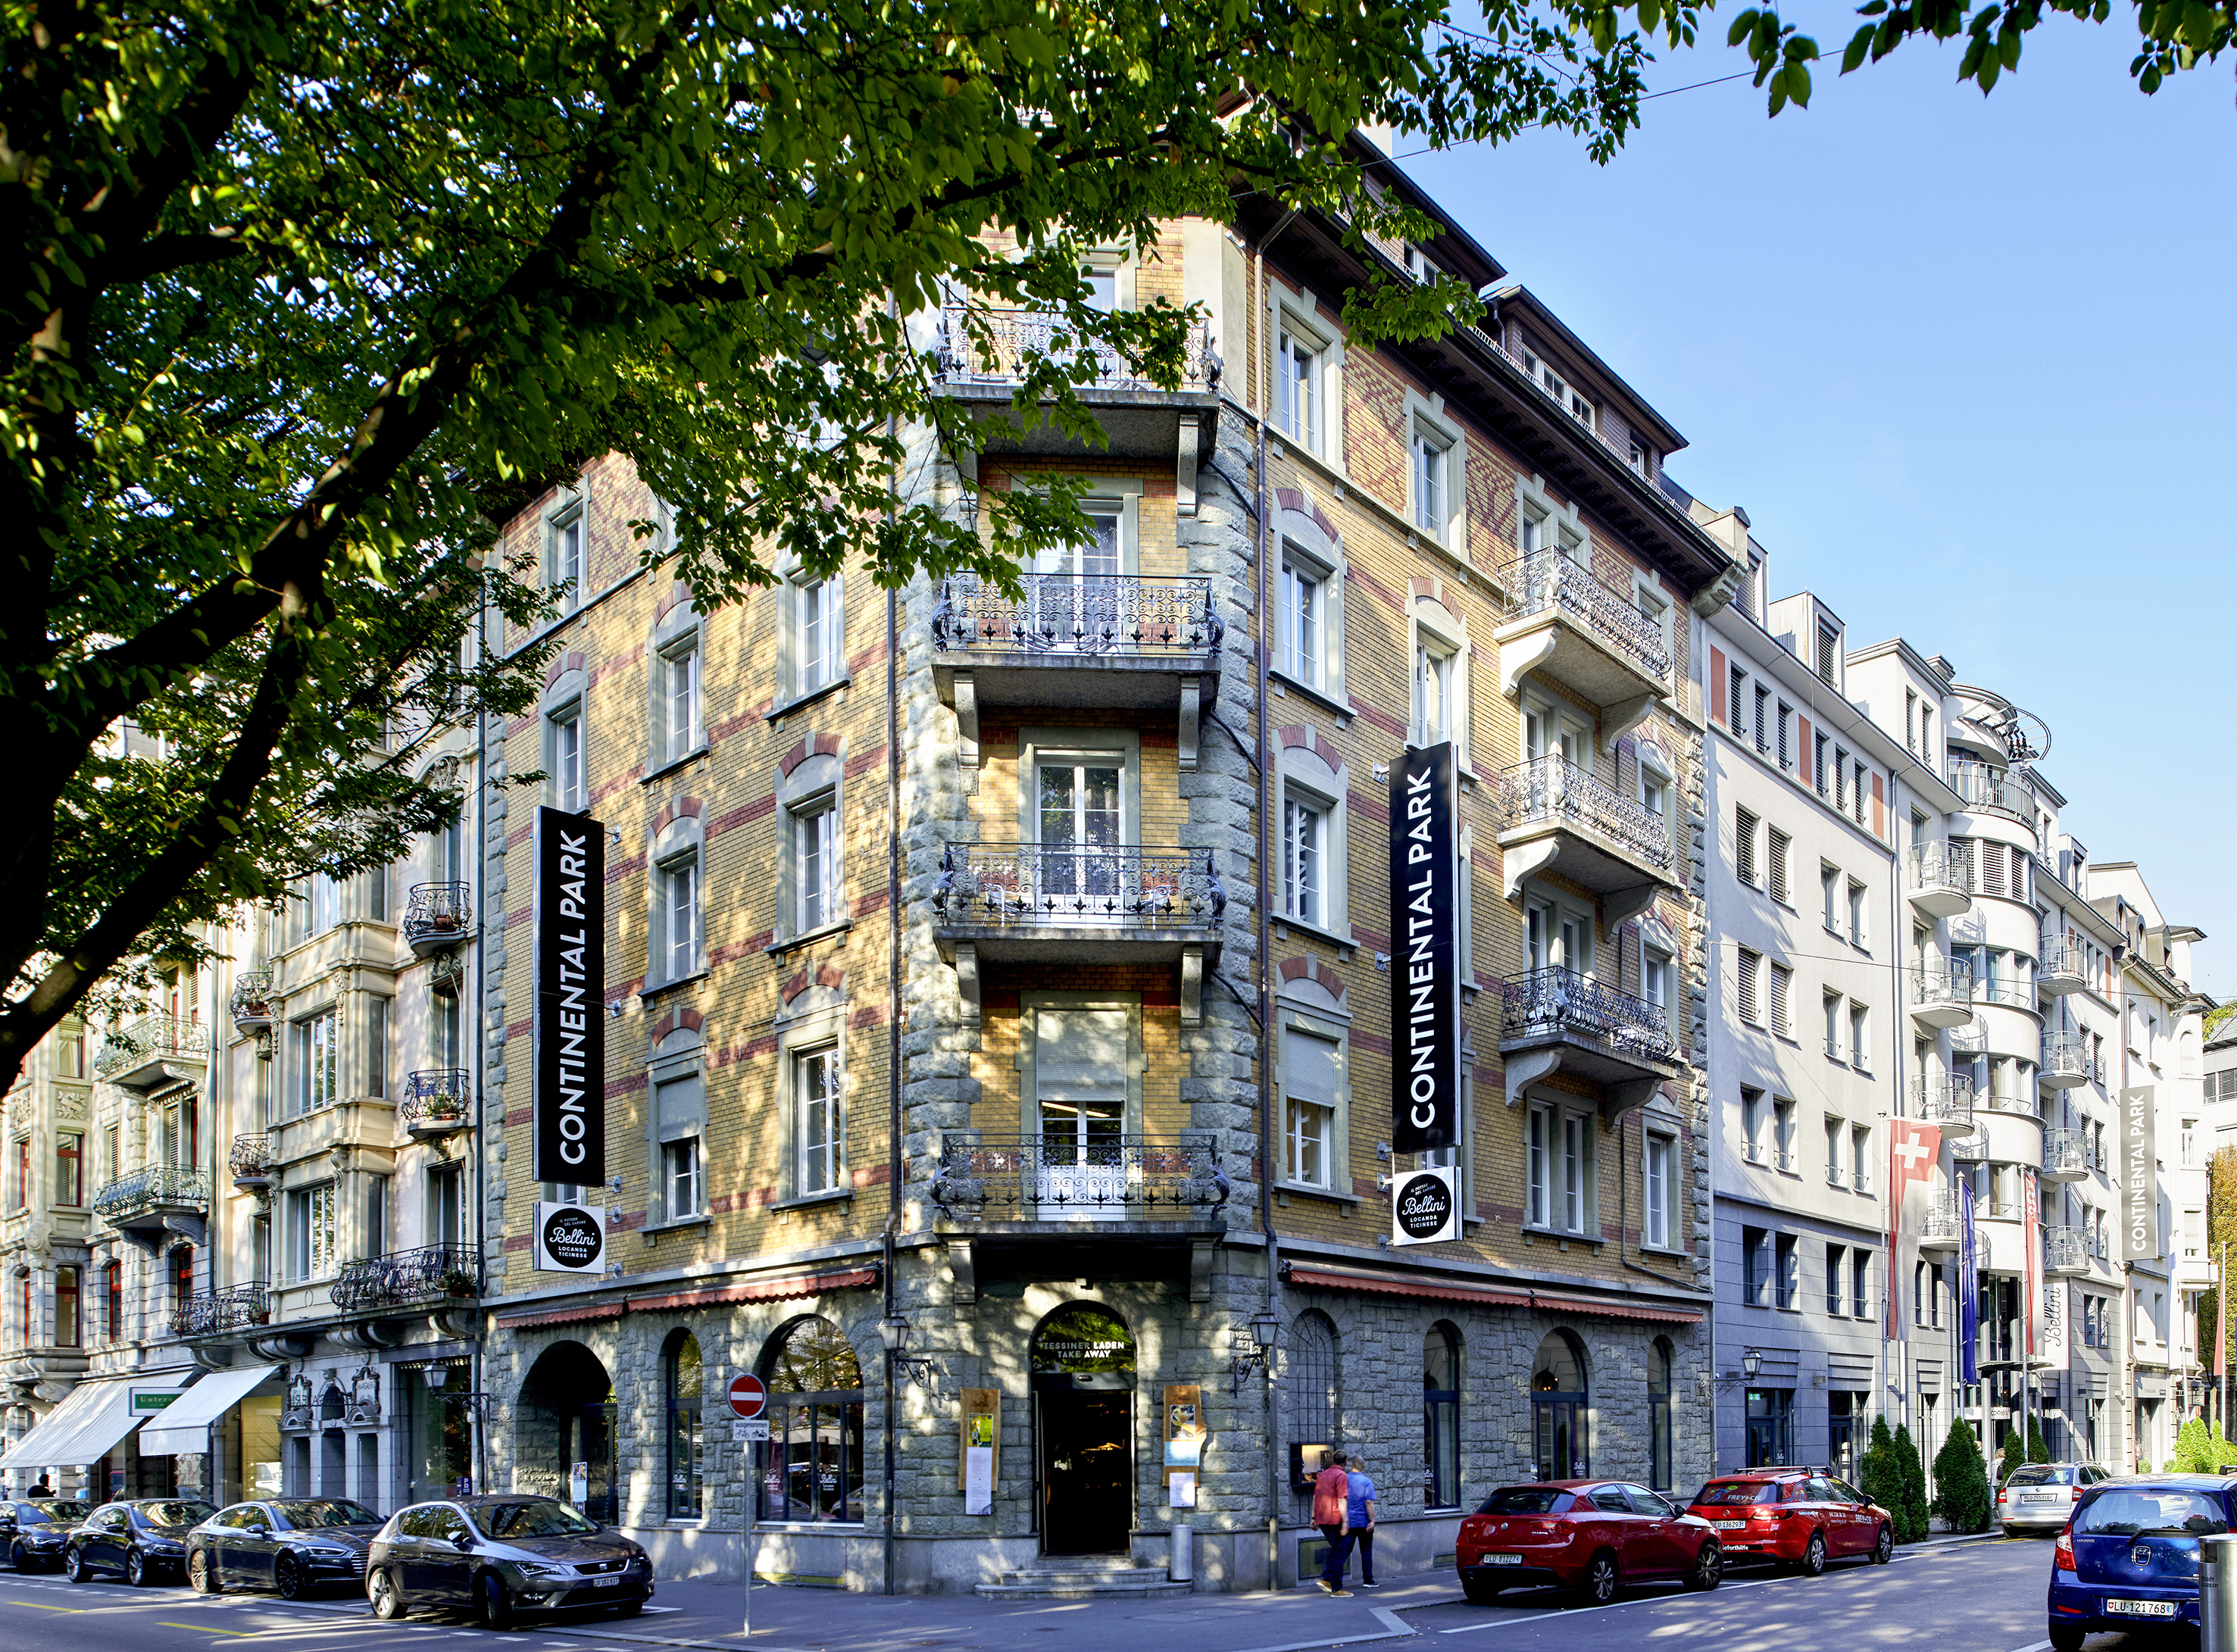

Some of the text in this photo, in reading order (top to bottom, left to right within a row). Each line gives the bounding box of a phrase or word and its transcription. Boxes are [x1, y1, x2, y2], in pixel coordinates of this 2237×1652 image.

[1407, 766, 1436, 1129] CONTINENTAL PARK
[560, 829, 586, 1164] CONTINENTAL PARK
[2129, 1094, 2147, 1251] CONTINENTAL PARK
[1415, 1183, 1428, 1191] POTERE
[1423, 1185, 1436, 1193] SAPORE
[1402, 1195, 1445, 1215] Bellini
[549, 1227, 595, 1245] Bellini
[2044, 1288, 2060, 1347] Bellini
[1084, 1350, 1111, 1358] AWAY
